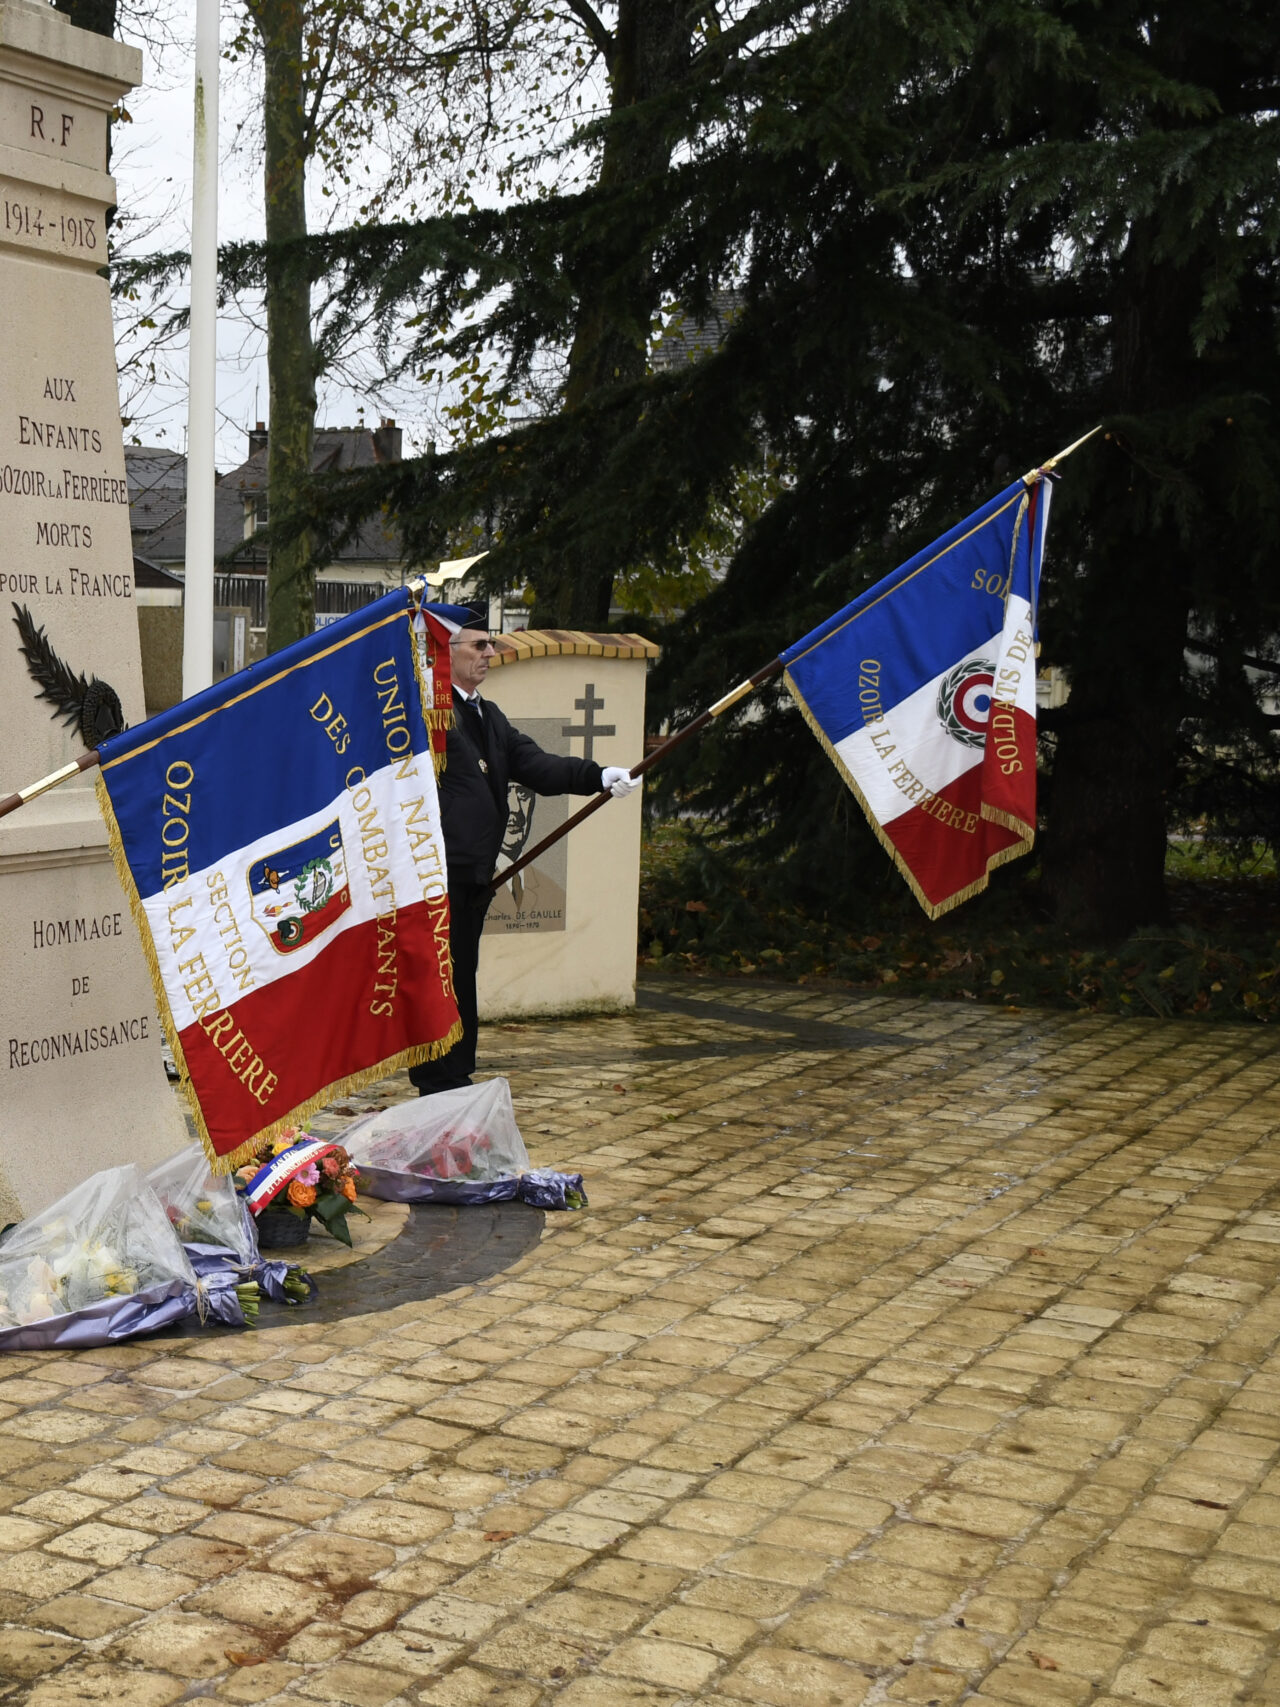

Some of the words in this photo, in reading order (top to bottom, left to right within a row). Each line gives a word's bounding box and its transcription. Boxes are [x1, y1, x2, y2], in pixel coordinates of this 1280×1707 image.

[5, 201, 96, 249] 1914-1918
[44, 377, 76, 402] AUX
[19, 416, 102, 453] ENFANTS
[48, 479, 62, 499] LA
[36, 522, 92, 548] MORTS
[0, 573, 38, 594] POUR
[46, 576, 62, 595] LA
[69, 568, 131, 597] FRANCE
[1006, 629, 1033, 663] DE
[427, 694, 451, 704] RERE
[858, 659, 885, 728] OZOIR
[991, 667, 1024, 776] SOLDATS
[871, 729, 896, 759] LA
[887, 760, 979, 834] FERRIERE
[161, 761, 194, 894] OZOIR
[372, 656, 418, 781] UNION
[400, 797, 454, 998] NATIONALE
[309, 692, 352, 755] DES
[345, 766, 398, 1019] COMBATTANTS
[33, 913, 122, 948] HOMMAGE
[168, 896, 196, 948] LA
[207, 870, 255, 991] SECTION
[516, 912, 525, 920] DE
[530, 910, 562, 919] GAULLE
[72, 976, 90, 996] DE
[9, 1016, 148, 1069] RECONNAISSANCE
[178, 959, 278, 1105] FERRIERE
